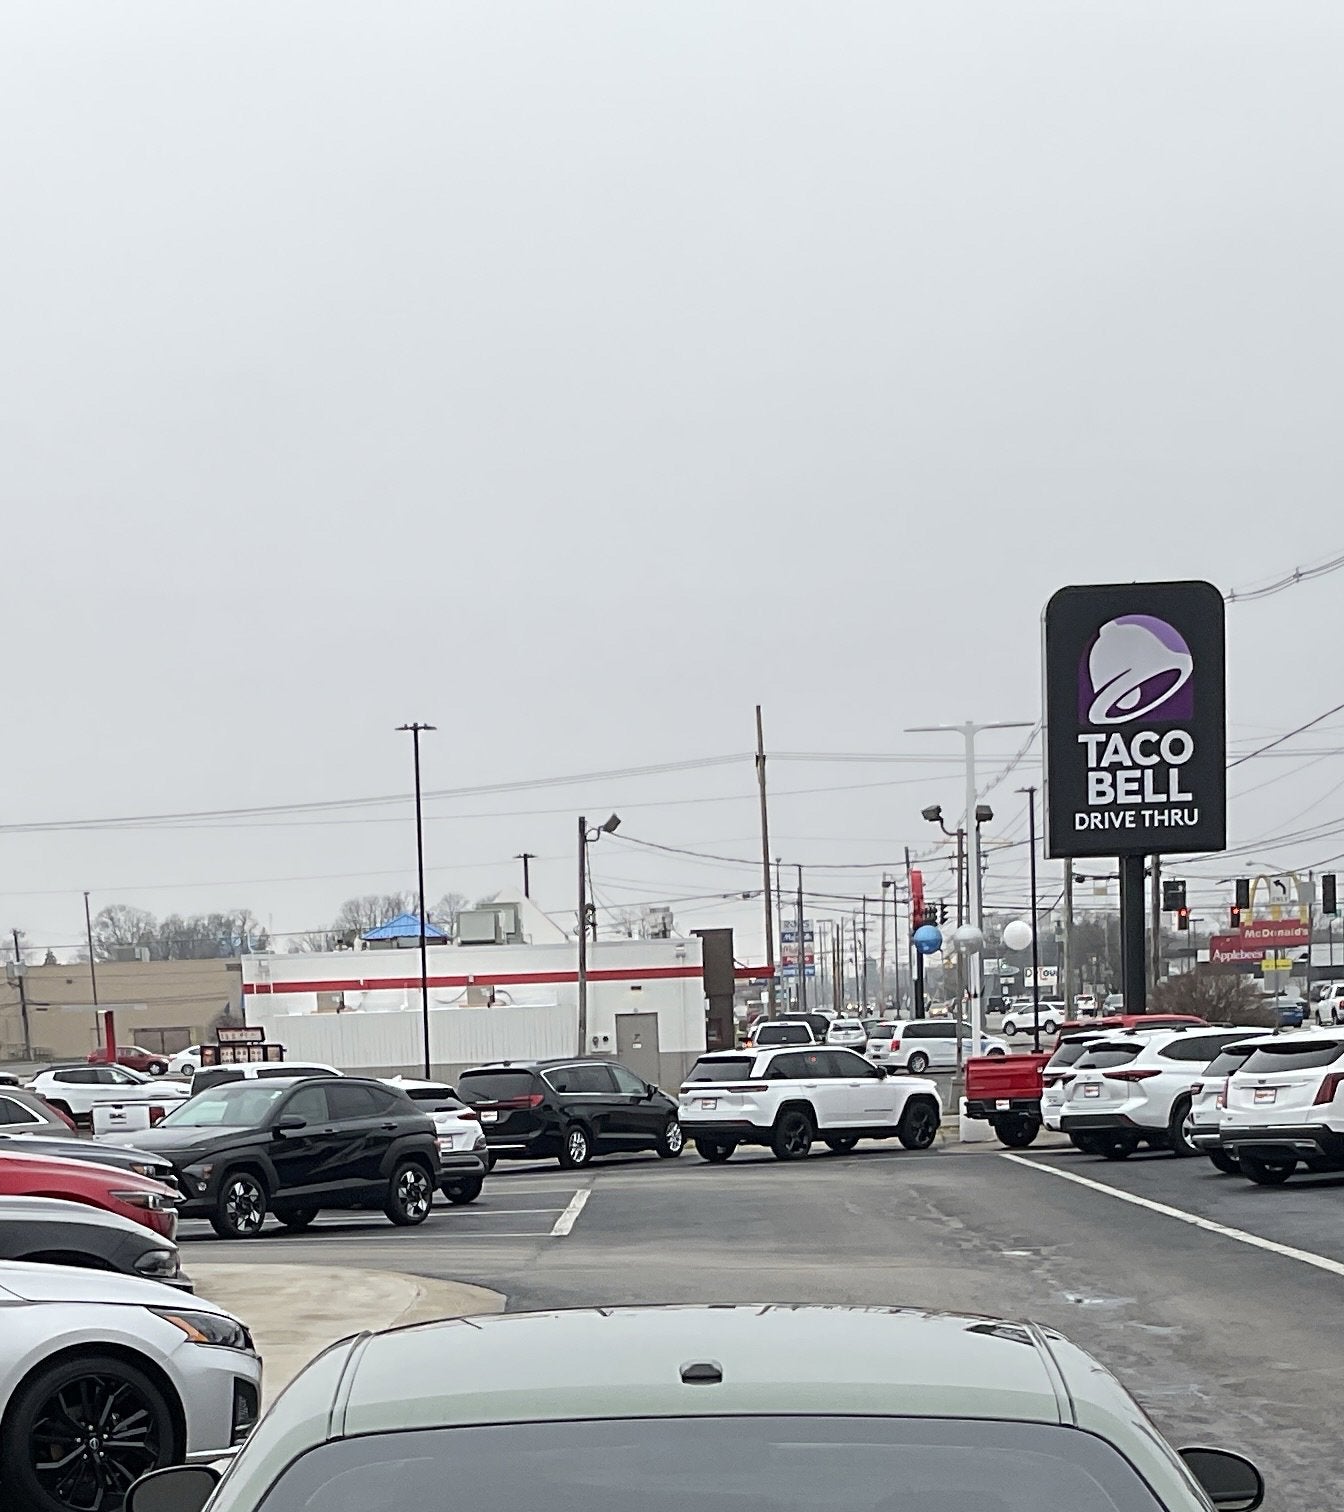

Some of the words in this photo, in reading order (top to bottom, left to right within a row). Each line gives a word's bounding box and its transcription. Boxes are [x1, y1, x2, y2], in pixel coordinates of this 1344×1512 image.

[1078, 730, 1194, 768] TACO
[1088, 768, 1193, 805] BELL
[1075, 810, 1136, 830] DRIVE
[1141, 808, 1199, 827] THRU
[1245, 927, 1309, 939] McDonald's
